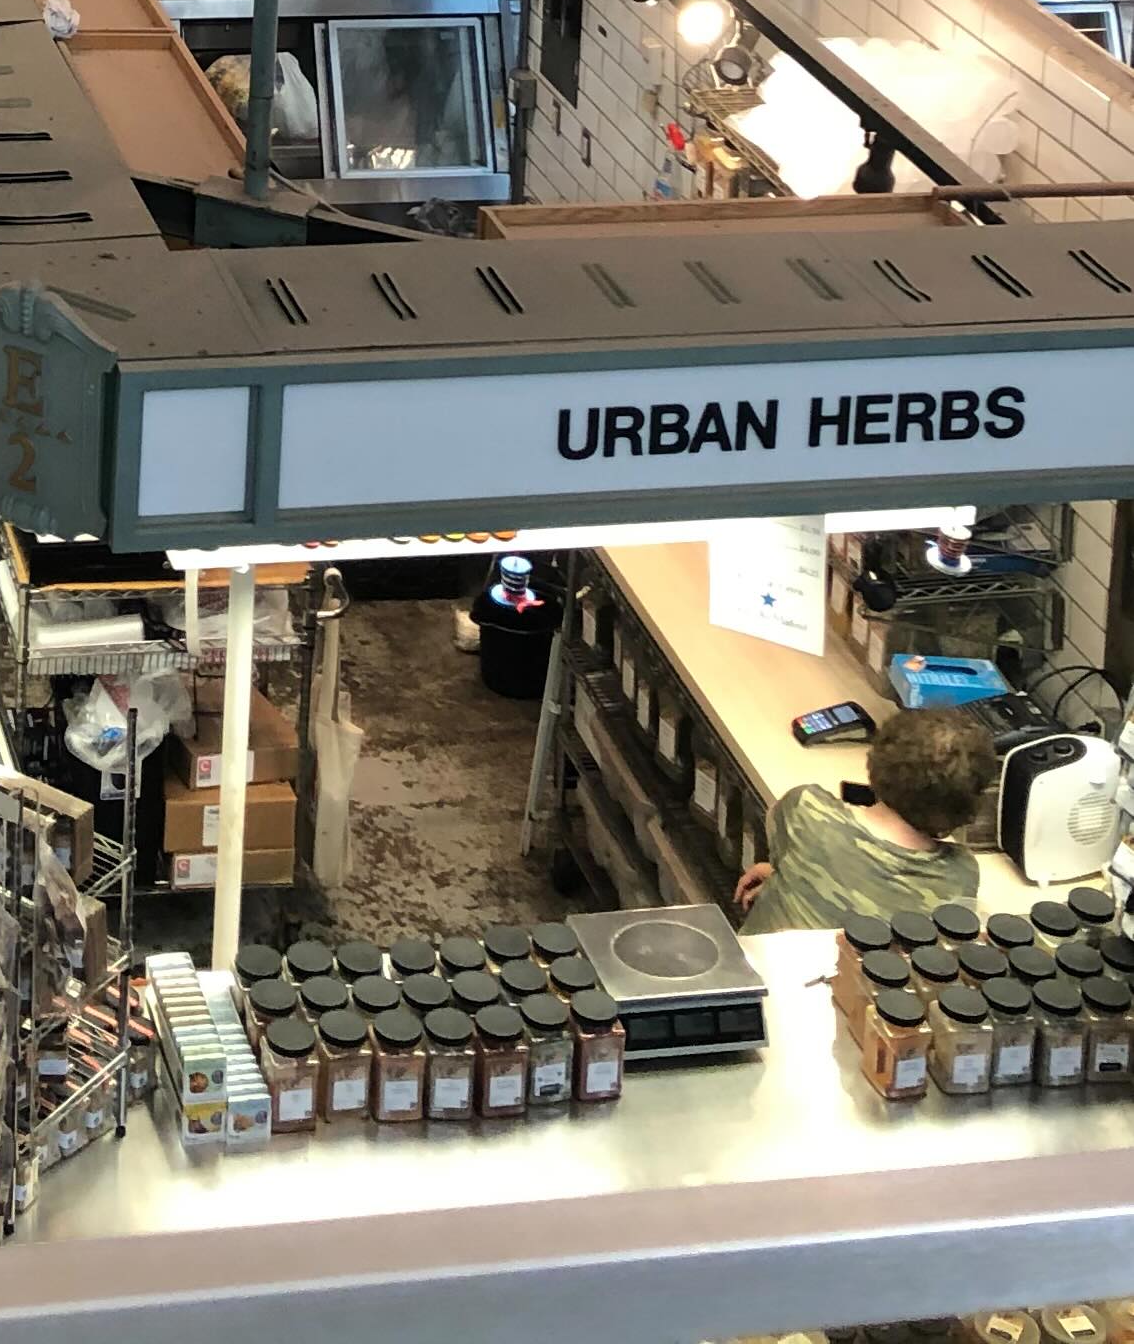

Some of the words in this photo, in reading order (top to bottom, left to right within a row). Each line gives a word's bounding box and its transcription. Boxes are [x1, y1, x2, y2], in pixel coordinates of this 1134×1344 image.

[2, 344, 44, 417] E
[557, 399, 779, 461] URBAN
[808, 386, 1026, 448] HERBS
[8, 431, 37, 495] 2
